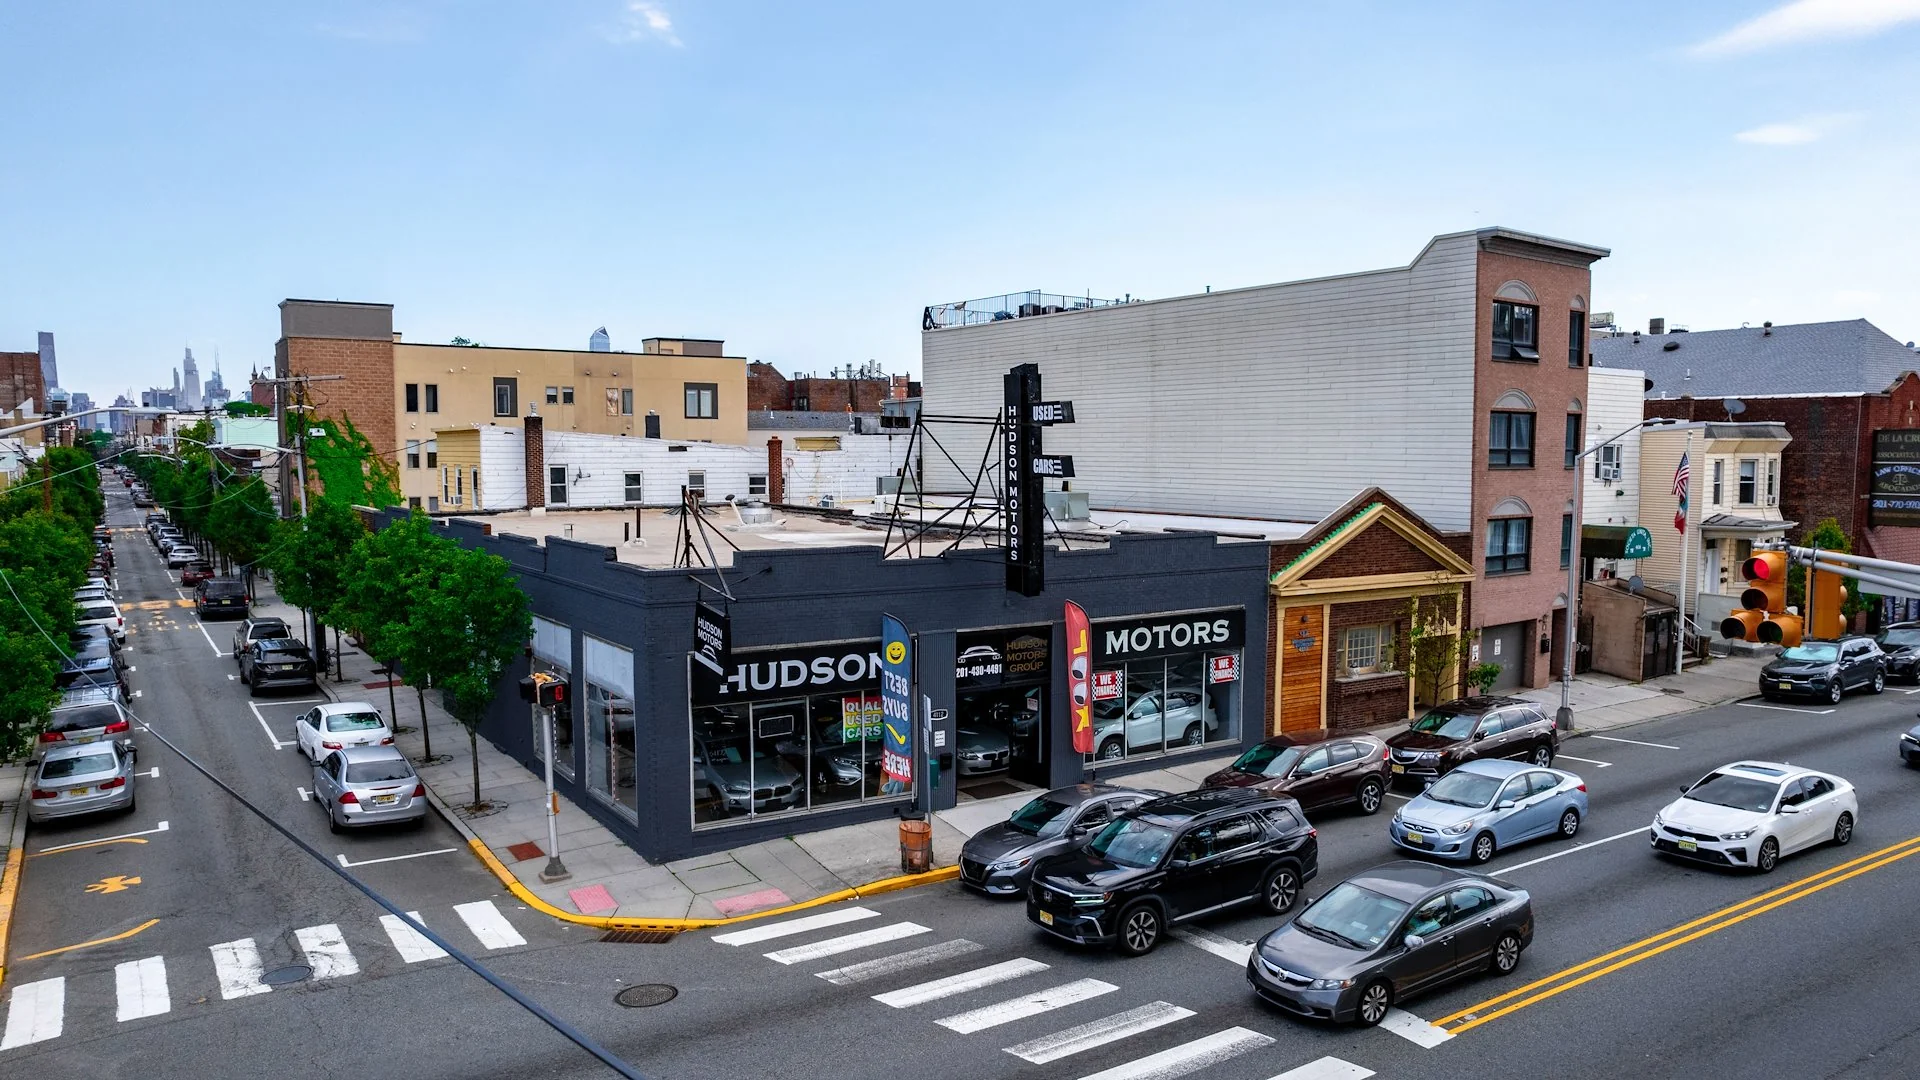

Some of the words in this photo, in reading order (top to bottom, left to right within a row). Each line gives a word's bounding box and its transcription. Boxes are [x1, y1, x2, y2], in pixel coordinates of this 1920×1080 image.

[1032, 404, 1054, 421] USED
[1008, 406, 1017, 481] HUDSON
[1892, 434, 1903, 443] LA
[1033, 458, 1054, 475] CARS
[1875, 466, 1892, 478] LAW
[1009, 486, 1018, 561] MOTORS
[697, 616, 723, 640] HUDSON
[697, 628, 723, 651] MOTORS
[1105, 619, 1230, 655] MOTORS
[1006, 639, 1048, 651] HUDSON
[1006, 650, 1047, 662] MOTORS
[956, 663, 1002, 678] 201-430-4491
[1009, 661, 1044, 673] GROUP
[1218, 658, 1230, 669] WE
[1099, 674, 1112, 686] WE
[846, 713, 881, 725] USED
[846, 725, 882, 739] CARS
